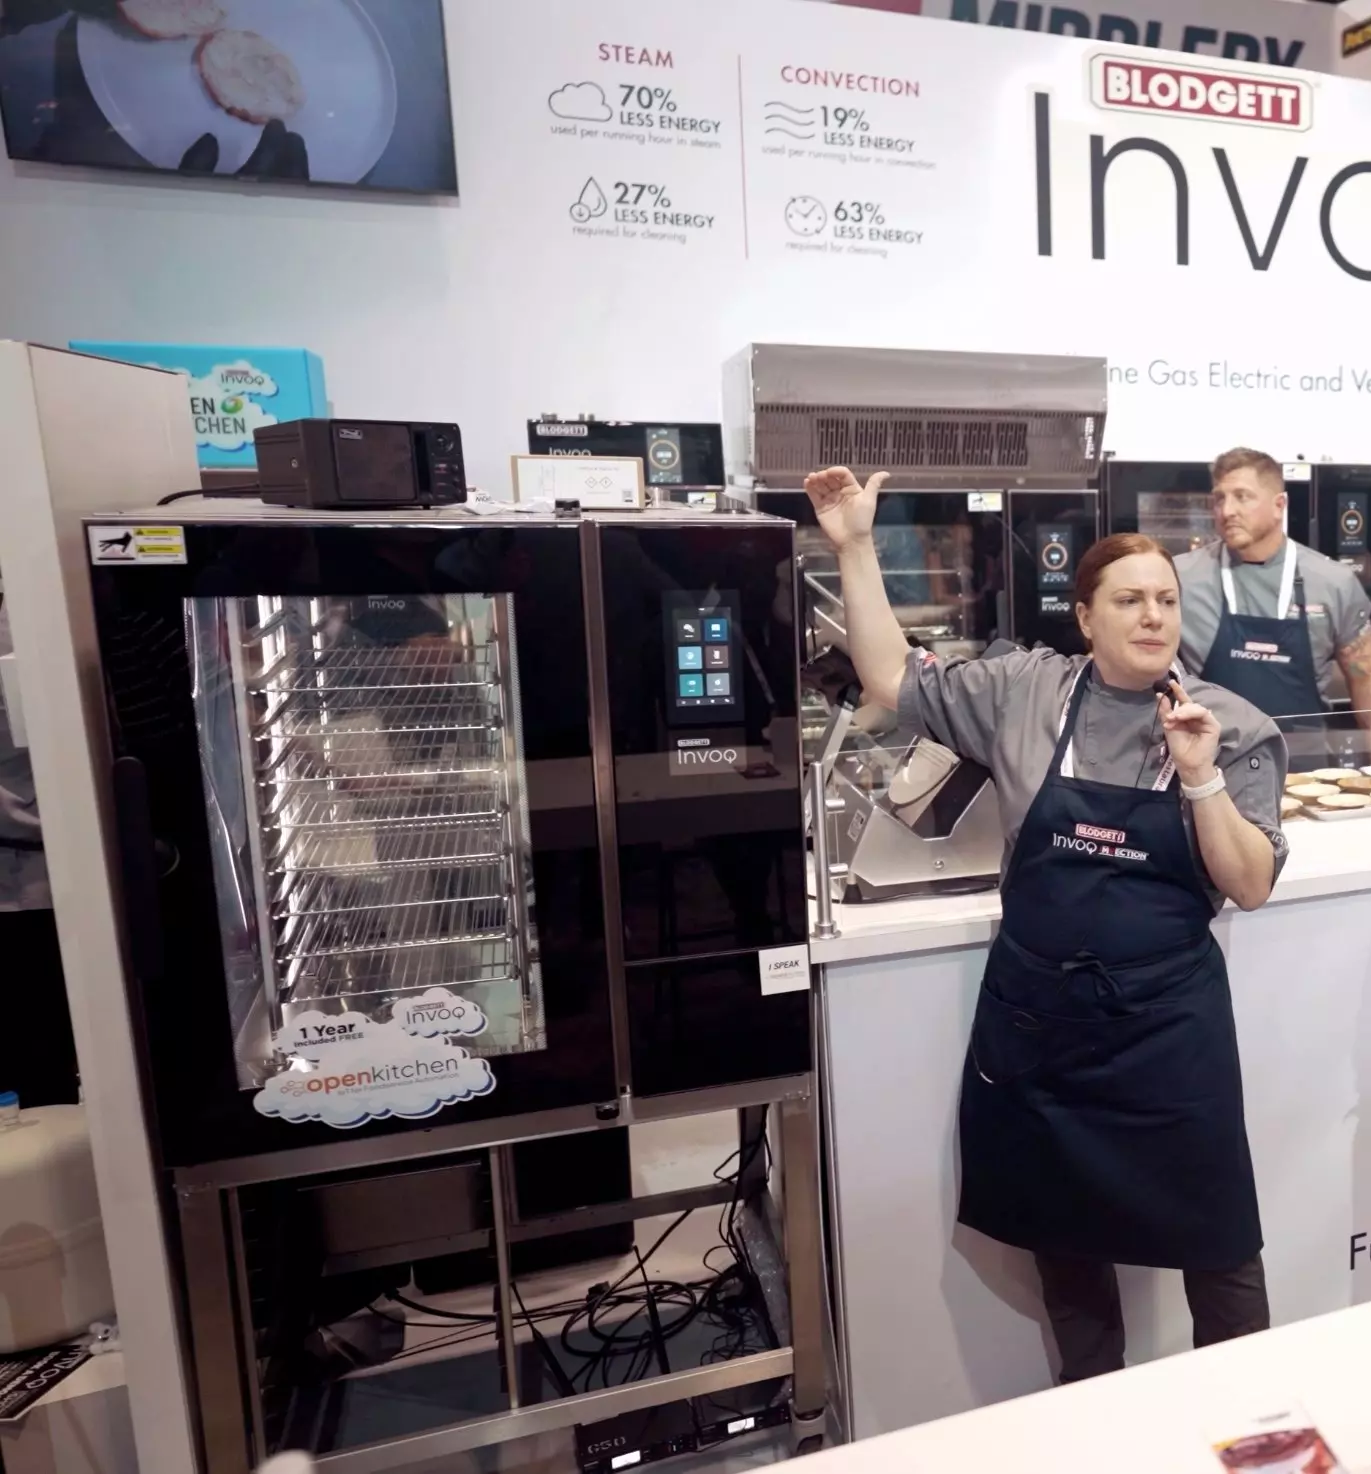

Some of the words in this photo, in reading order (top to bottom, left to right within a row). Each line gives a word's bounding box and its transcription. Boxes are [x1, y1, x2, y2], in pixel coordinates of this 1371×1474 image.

[598, 43, 674, 69] STEAM
[781, 65, 920, 98] CONVECTION
[619, 84, 677, 112] 70%
[1105, 66, 1298, 122] BLODGETT
[620, 111, 654, 128] LESS
[659, 114, 721, 134] ENERGY
[820, 105, 870, 132] 19%
[550, 124, 576, 136] used
[580, 128, 598, 139] per
[824, 132, 854, 148] LESS
[860, 135, 915, 153] ENERGY
[614, 181, 671, 209] 27%
[615, 208, 649, 224] LESS
[653, 211, 715, 229] ENERGY
[834, 201, 885, 225] 63%
[834, 225, 864, 240] LESS
[869, 228, 924, 244] ENERGY
[1109, 365, 1138, 384] ne
[1148, 359, 1198, 387] Gas
[1209, 359, 1290, 391] Electric
[1299, 365, 1343, 392] and
[191, 397, 216, 415] EN
[195, 417, 247, 435] CHEN
[773, 960, 800, 970] SPEAK
[294, 1035, 337, 1049] Included
[338, 1032, 364, 1041] FREE
[299, 1027, 307, 1039] 1
[313, 1022, 356, 1038] Year
[307, 1057, 459, 1094] openkitchen
